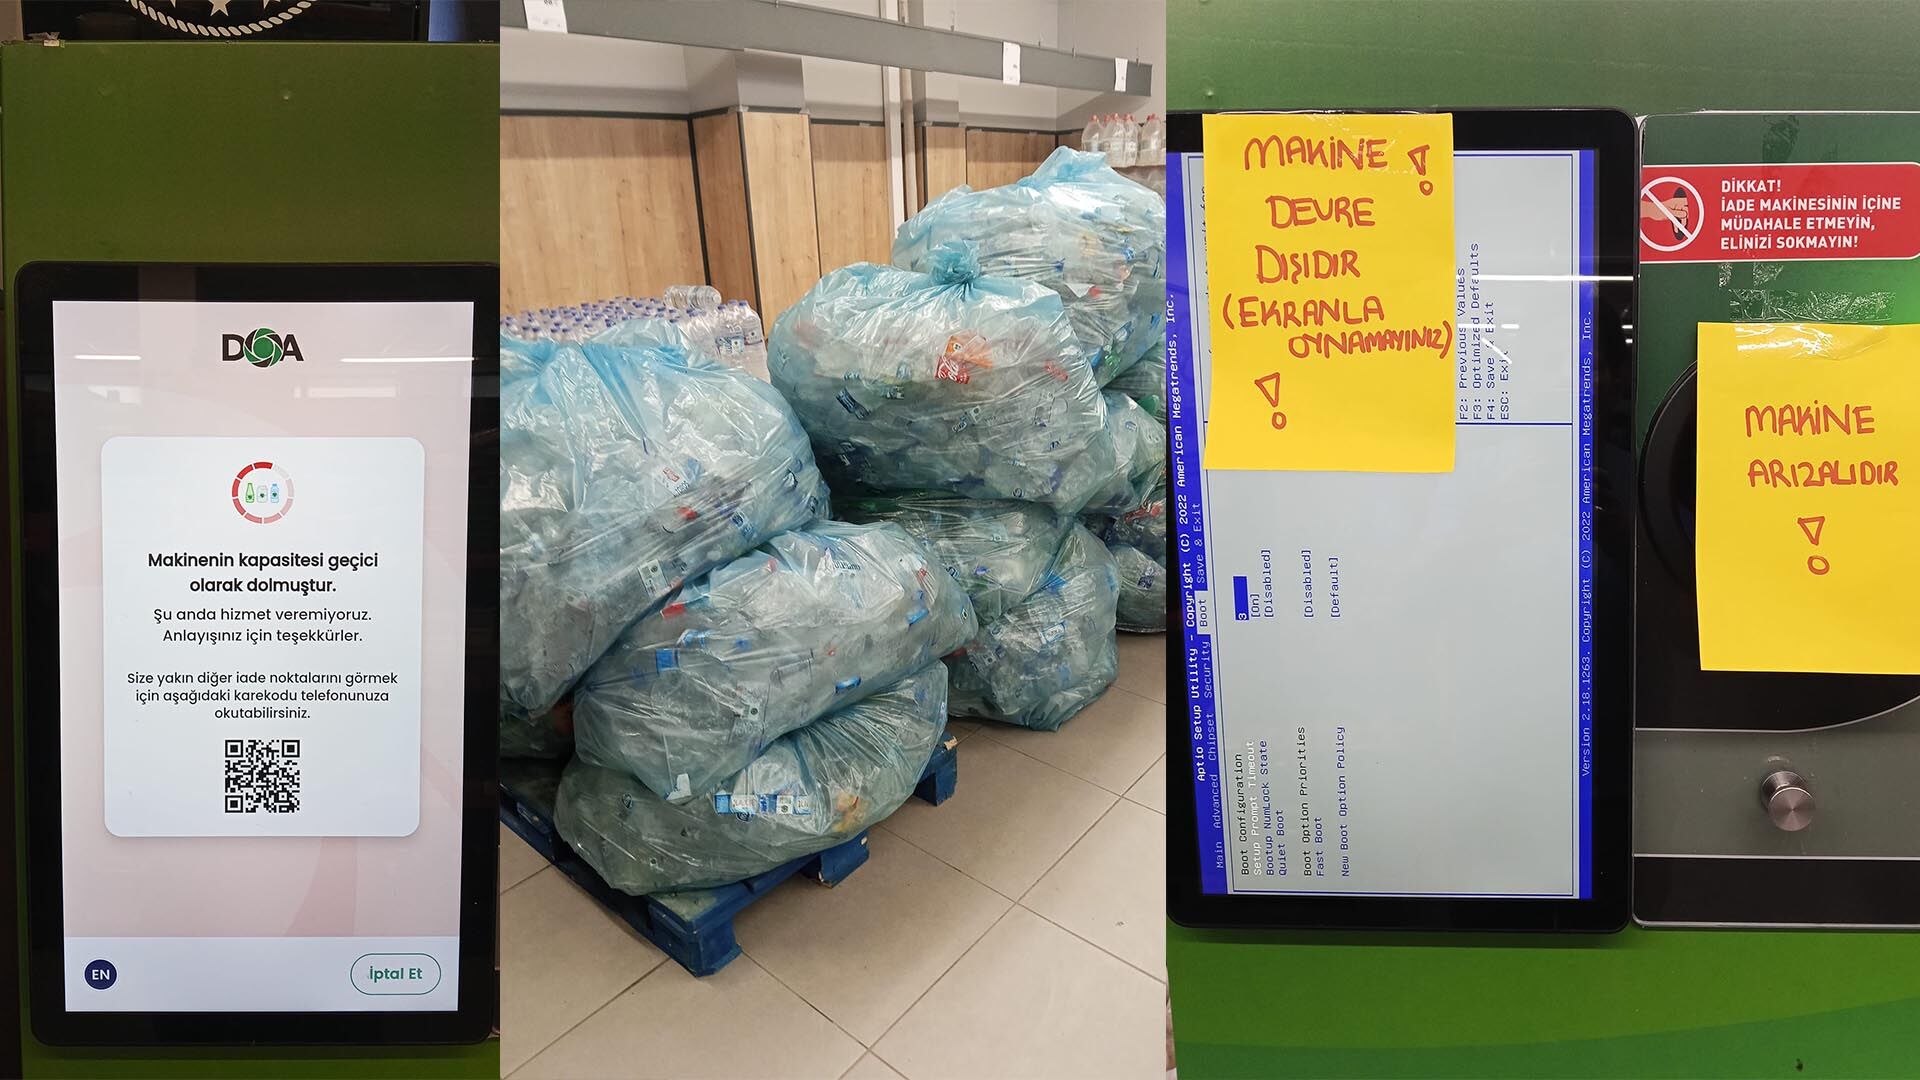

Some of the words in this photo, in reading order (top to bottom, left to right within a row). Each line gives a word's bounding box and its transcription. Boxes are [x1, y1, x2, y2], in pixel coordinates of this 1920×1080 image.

[1245, 135, 1388, 171] MAKİNE
[1721, 177, 1781, 193] DİKKAT!
[1265, 195, 1376, 228] DEVRE
[1721, 197, 1755, 212] İADE
[1760, 195, 1858, 211] MAKİNESİNİN
[1862, 195, 1901, 213] İÇİNE
[1721, 215, 1801, 231] MÜDAHALE
[1806, 214, 1875, 231] ETMEYİN,
[1721, 234, 1773, 250] ELİNİZİ
[1776, 236, 1858, 250] SOKMAYIN!
[1255, 245, 1360, 284] DIŞIDIR
[1470, 244, 1480, 308] Defaults
[1457, 268, 1465, 316] Values
[1166, 294, 1175, 323] Inc.
[1222, 293, 1385, 329] (EKRANLA
[1485, 302, 1494, 333] Exit
[1582, 311, 1591, 340] Inc.
[1459, 327, 1467, 388] Previous
[1471, 317, 1482, 388] Optimized
[1168, 334, 1182, 418] Megatrends,
[1486, 357, 1495, 388] Save
[1459, 398, 1468, 419] F2:
[1473, 398, 1481, 419] F3:
[1487, 398, 1495, 419] F4:
[1500, 391, 1509, 419] ESC:
[1582, 351, 1592, 435] Megatrends,
[1745, 400, 1875, 437] MAKİNE
[1174, 426, 1186, 486] American
[1582, 444, 1590, 503] American
[1748, 460, 1899, 488] ARIZALIDIR
[1178, 494, 1187, 524] 2022
[1192, 503, 1202, 532] Exit
[1582, 512, 1590, 540] 2022
[1180, 533, 1190, 552] (C)
[148, 553, 234, 568] Makinenin
[239, 553, 324, 571] kapasitesi
[328, 553, 378, 571] geçici
[1196, 554, 1205, 583] Save
[1581, 550, 1591, 568] (C)
[190, 578, 242, 592] olarak
[247, 578, 336, 596] dolmuştur.
[1182, 563, 1196, 627] Copyright
[1261, 550, 1273, 617] [Disabled]
[1302, 550, 1314, 617] [Disabled]
[1329, 557, 1340, 617] [Default]
[154, 608, 172, 624] Şu
[176, 608, 216, 620] anda
[220, 608, 271, 620] hizmet
[276, 608, 372, 624] veremiyoruz.
[1198, 599, 1207, 626] Boot
[1250, 594, 1260, 617] [On]
[1582, 578, 1591, 642] Copyright
[163, 629, 242, 645] Anlayışınız
[247, 629, 272, 645] için
[276, 629, 363, 645] teşekkürler.
[127, 672, 154, 684] Size
[157, 672, 193, 687] yakın
[197, 672, 232, 687] diğer
[236, 672, 266, 684] iade
[270, 672, 342, 684] noktalarını
[345, 672, 398, 687] görmek
[1188, 648, 1200, 698] Utility
[1201, 641, 1213, 698] Security
[136, 690, 159, 705] için
[163, 690, 230, 705] aşağıdaki
[234, 690, 297, 702] karekodu
[301, 689, 389, 702] telefonunuza
[1582, 651, 1590, 720] 2.18.1263.
[215, 707, 311, 719] okutabilirsiniz.
[1192, 705, 1203, 740] Setup
[1206, 713, 1216, 760] Chipset
[1336, 727, 1346, 768] Policy
[1582, 728, 1590, 776] Version
[1195, 747, 1206, 781] Aptio
[1246, 741, 1256, 787] Timeout
[1259, 740, 1268, 775] State
[1297, 727, 1308, 795] Priorities
[1210, 774, 1221, 828] Advanced
[1234, 754, 1247, 842] Configuration
[1261, 782, 1271, 829] NumLock
[1338, 776, 1348, 816] Option
[1249, 796, 1259, 835] Prompt
[1276, 810, 1284, 836] Boot
[1300, 803, 1311, 843] Option
[1314, 817, 1323, 843] Boot
[1340, 824, 1348, 850] Boot
[1215, 842, 1223, 868] Main
[1240, 850, 1249, 875] Boot
[1253, 843, 1263, 875] Setup
[1265, 836, 1274, 875] Bootup
[1278, 844, 1287, 875] Quiet
[1303, 851, 1312, 876] Boot
[1316, 851, 1324, 876] Fast
[1341, 856, 1349, 876] New
[92, 968, 110, 980] EN
[369, 966, 404, 982] İptal
[409, 967, 423, 980] Et
